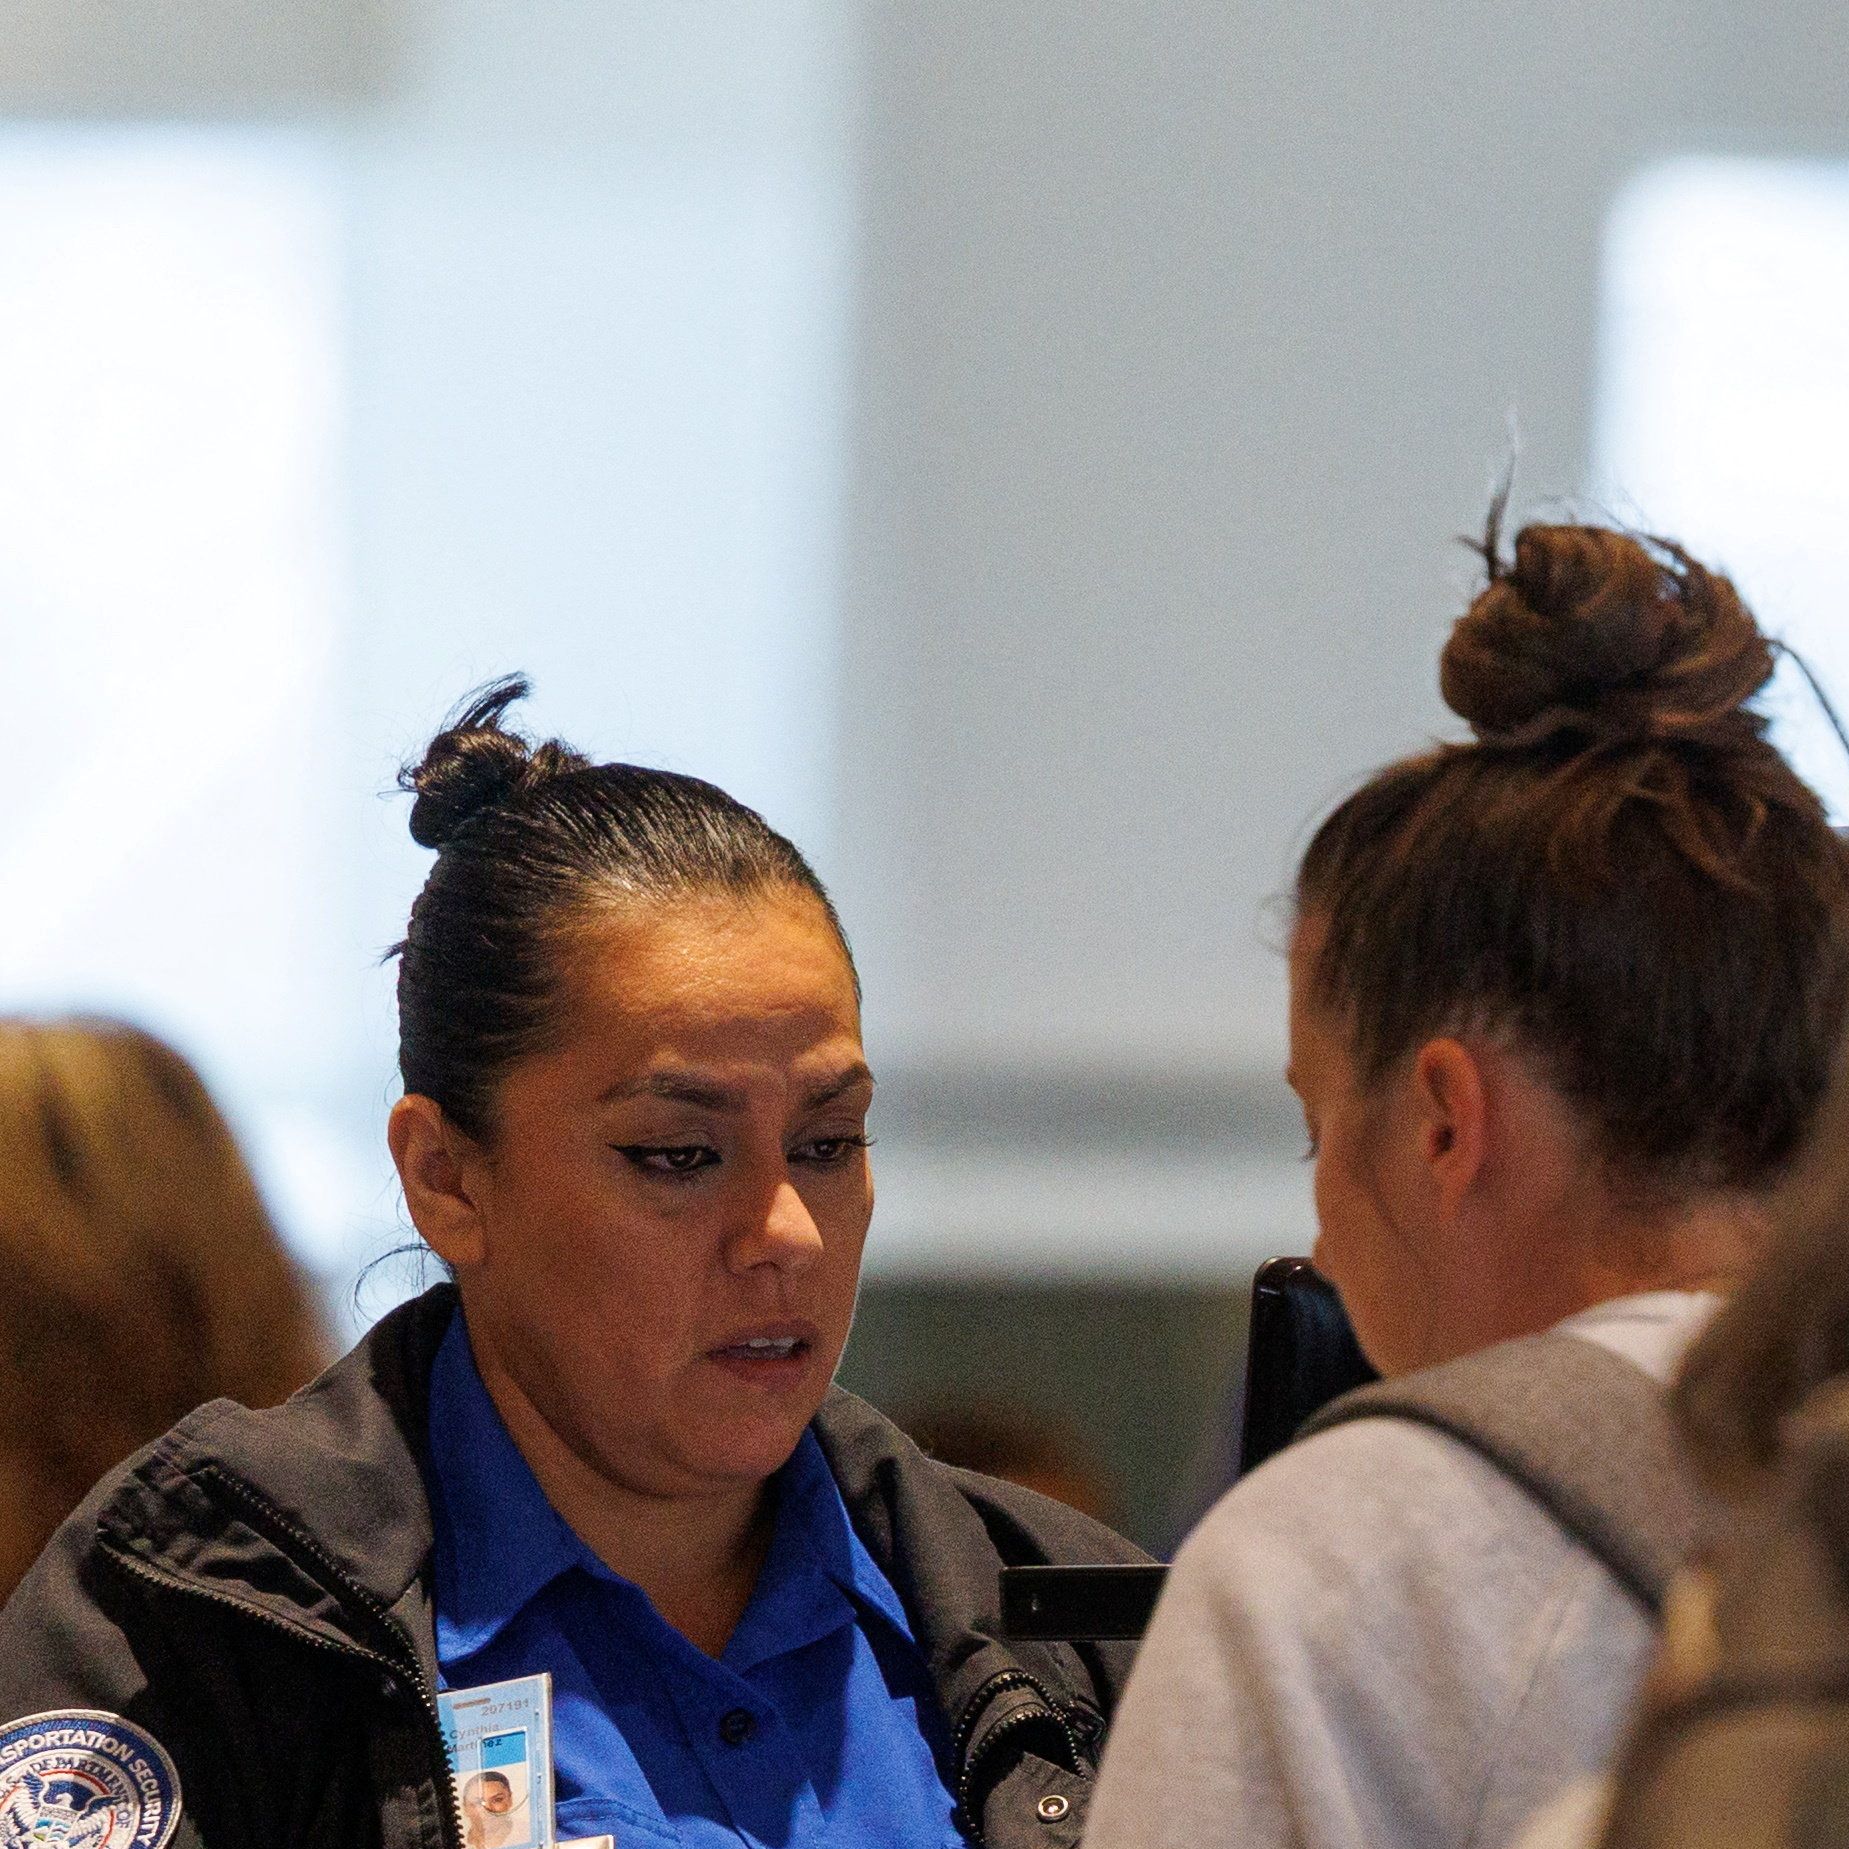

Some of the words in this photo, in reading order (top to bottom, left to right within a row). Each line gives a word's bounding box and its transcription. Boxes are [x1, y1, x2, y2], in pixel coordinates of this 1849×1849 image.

[449, 1724, 500, 1740] Cynthia
[0, 1729, 135, 1763] SPORTATION
[129, 1757, 163, 1847] SECURITY
[31, 1756, 130, 1804] DEPARTMENT
[116, 1810, 132, 1829] OF
